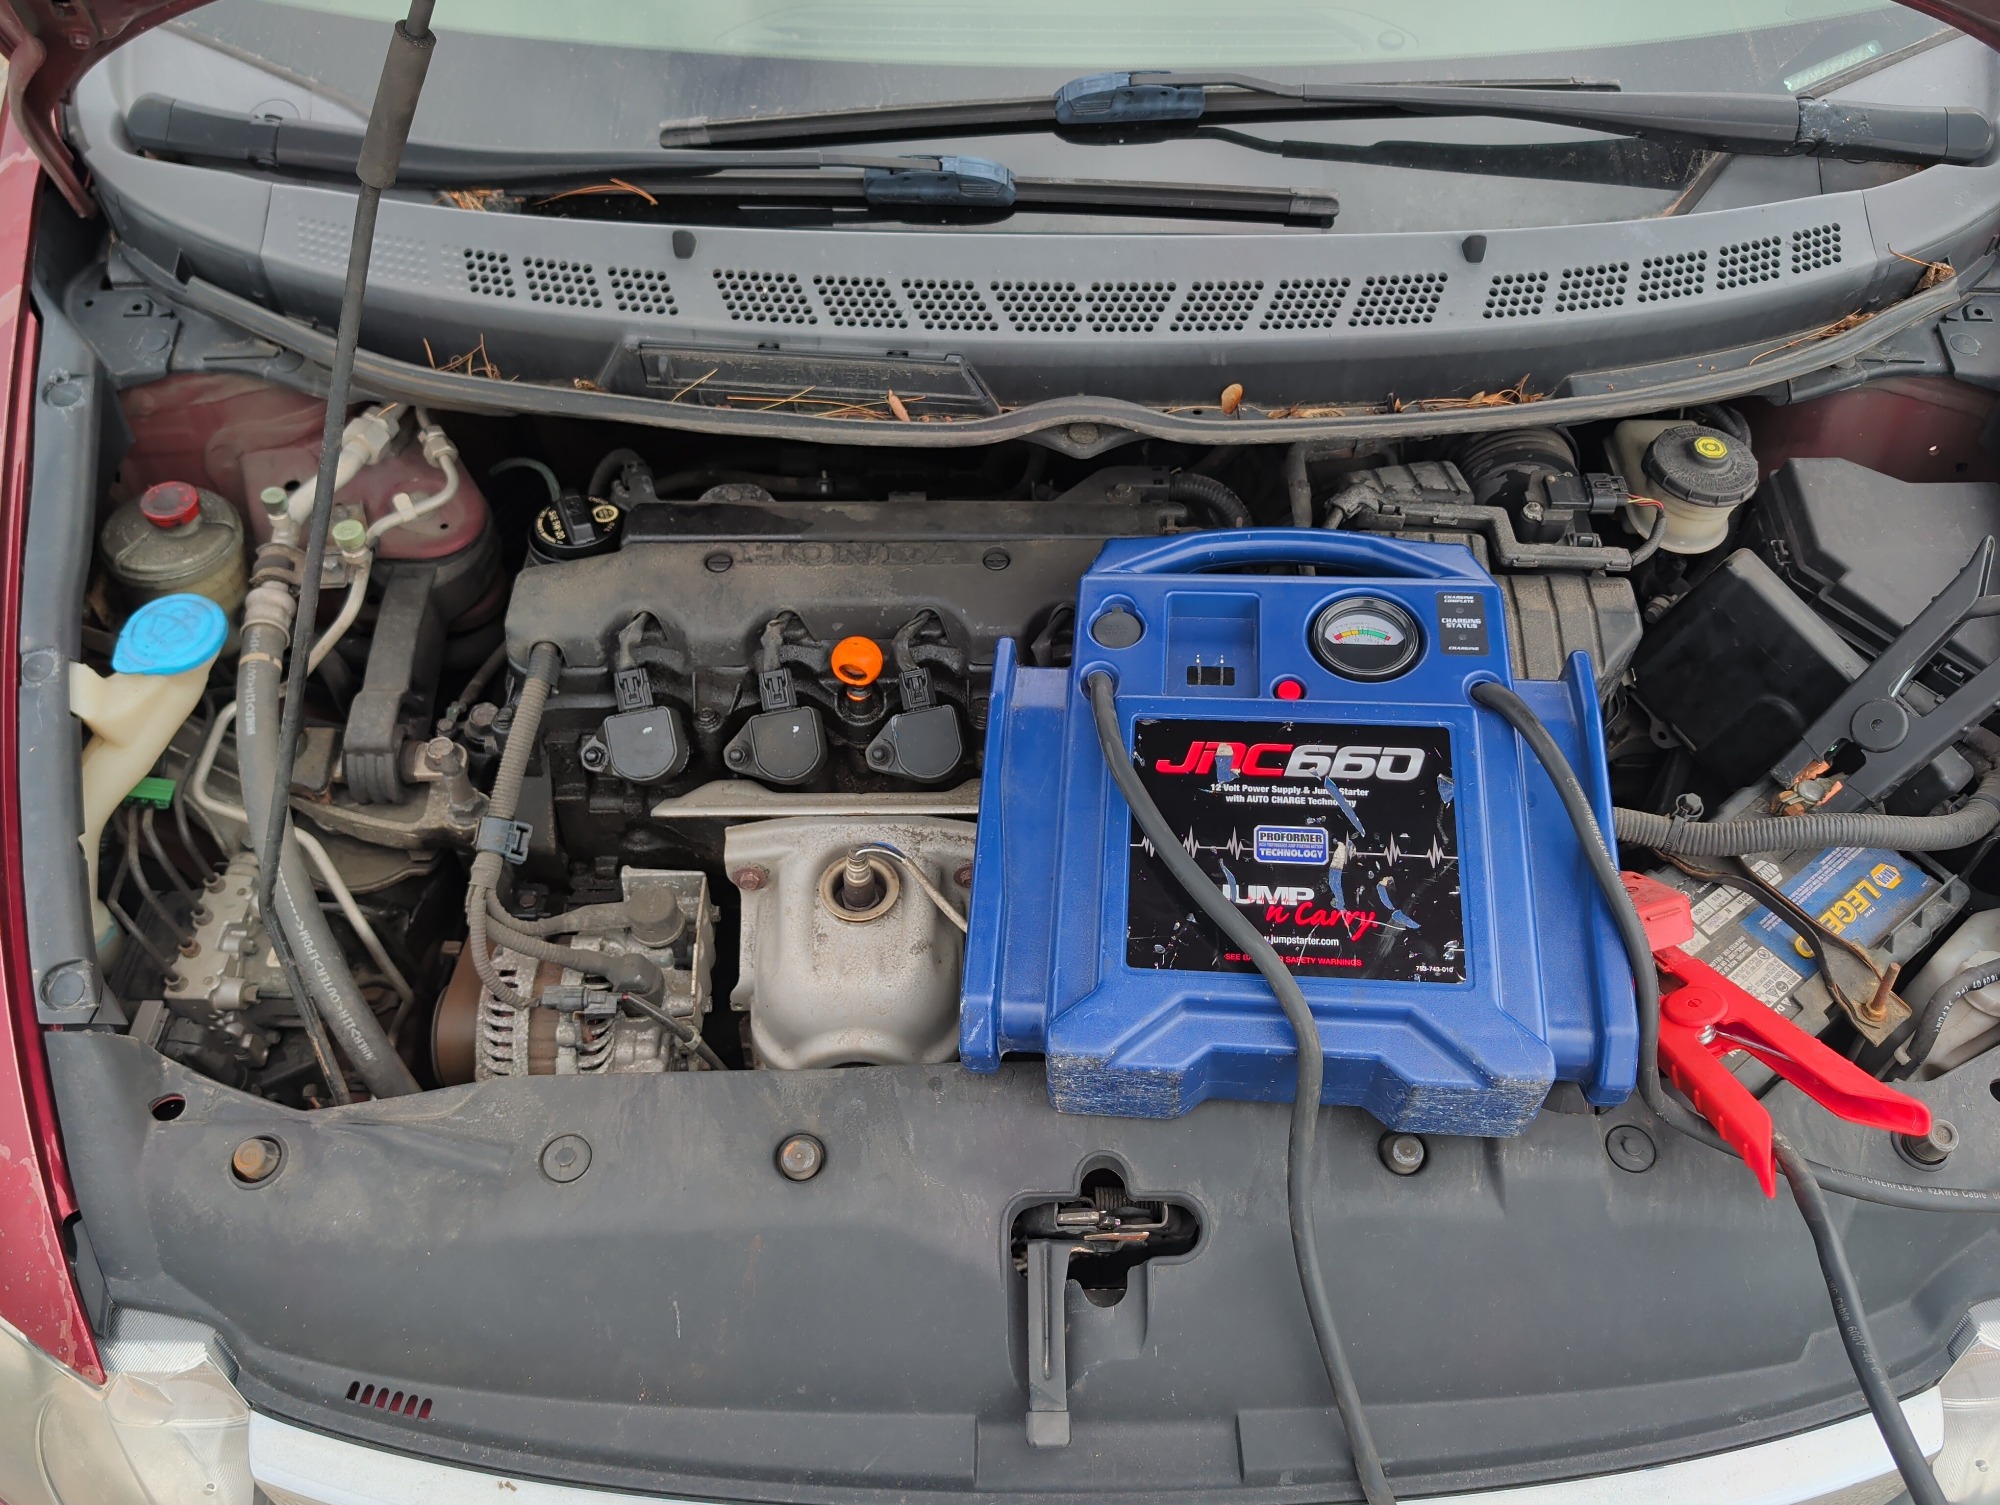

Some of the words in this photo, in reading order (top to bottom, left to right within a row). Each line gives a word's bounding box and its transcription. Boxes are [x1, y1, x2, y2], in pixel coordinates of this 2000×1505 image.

[739, 542, 978, 566] HONDA
[1210, 784, 1221, 792] 12
[1222, 784, 1240, 793] Volt
[1241, 784, 1269, 794] Power
[1271, 785, 1301, 795] Supply
[1304, 786, 1311, 795] &
[1225, 795, 1245, 803] with
[1247, 795, 1269, 803] AUTO
[1271, 796, 1306, 805] CHARGE
[1259, 832, 1322, 842] PROFORMER
[1260, 848, 1323, 858] TECHNOLOGY
[1874, 865, 1897, 886] NAPA
[1793, 878, 1882, 959] LEGED
[1286, 956, 1316, 964] SAFETY
[1318, 957, 1362, 967] WARNINGS
[1962, 1190, 1987, 1199] Cable
[1835, 1298, 1850, 1322] Cable
[1847, 1326, 1867, 1346] 600V
